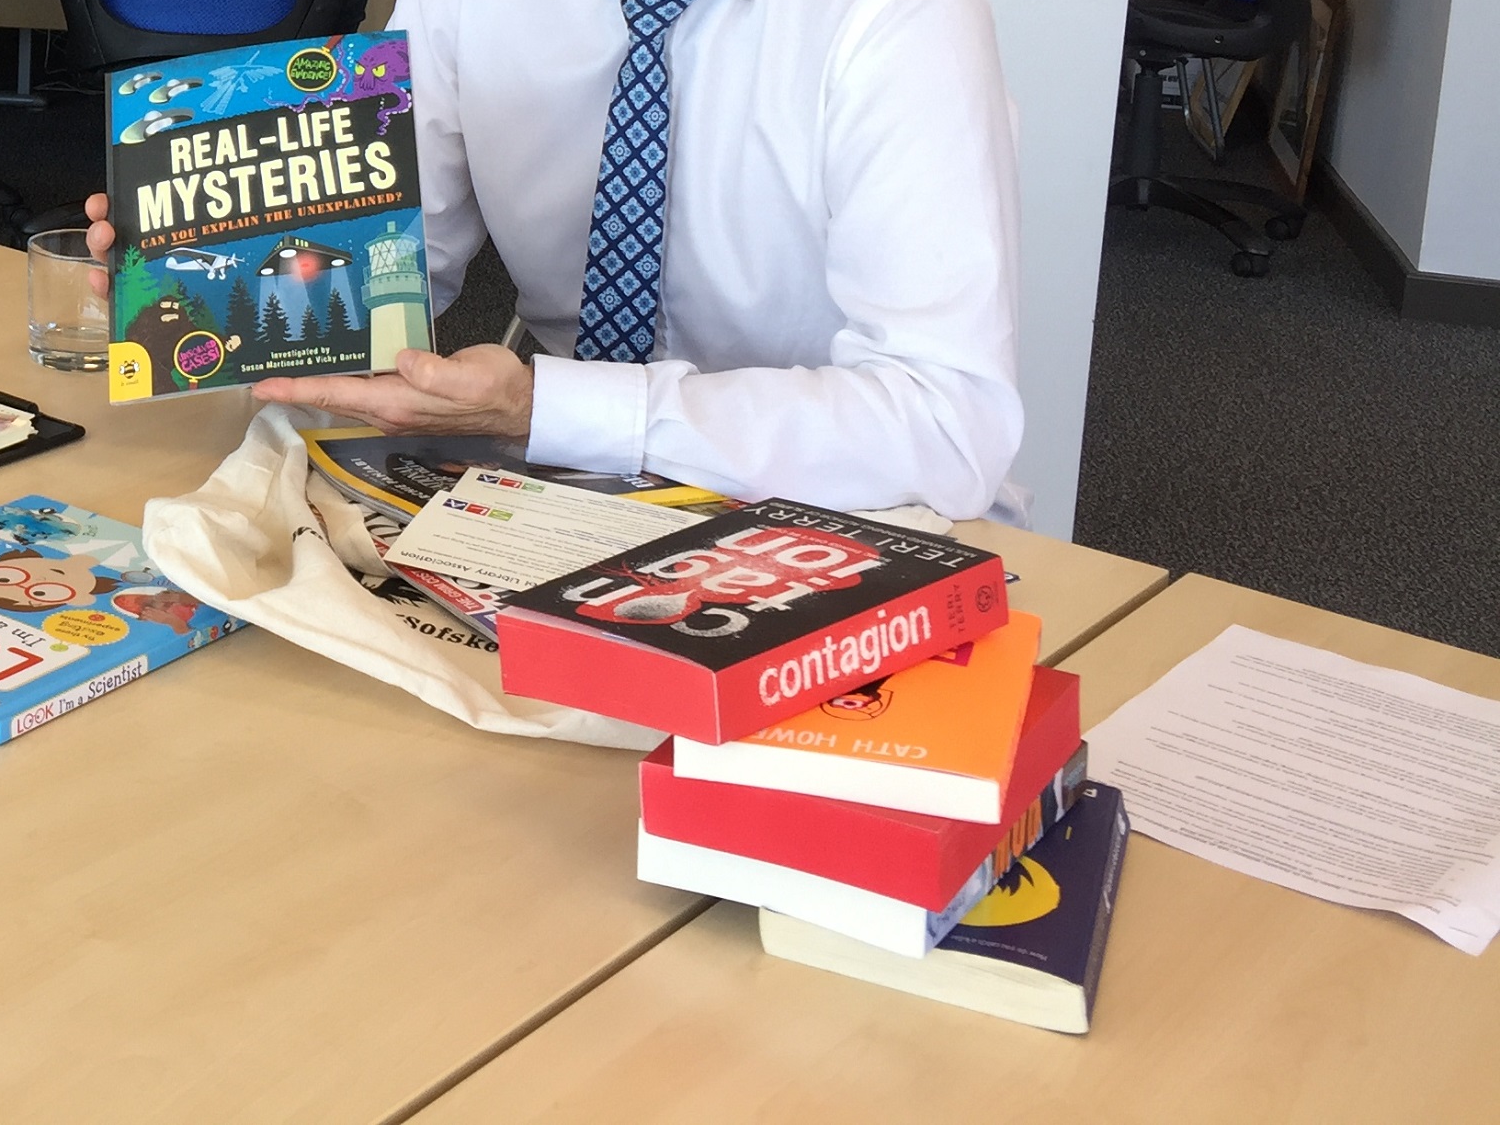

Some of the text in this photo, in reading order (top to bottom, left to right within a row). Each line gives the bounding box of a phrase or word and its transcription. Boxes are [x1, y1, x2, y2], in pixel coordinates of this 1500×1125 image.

[292, 57, 331, 70] AMAZING
[170, 107, 354, 174] REAL-LIFE
[137, 141, 397, 233] MYSTERIES
[140, 191, 403, 250] CAN YOU EXPLAIN THE UNEXPLAINED?
[181, 347, 220, 373] CASES!
[240, 363, 264, 373] Susan
[266, 358, 305, 369] Martineau
[306, 357, 314, 365] &
[339, 351, 366, 362] Barker
[270, 346, 331, 360] Investigated by
[743, 505, 965, 568] TERI TERRY
[399, 549, 472, 573] Association
[475, 567, 521, 587] Library
[12, 628, 47, 648] I'm
[758, 605, 932, 707] contagion
[17, 660, 142, 734] LOOK I'm a Scientist
[852, 739, 928, 760] CATH
